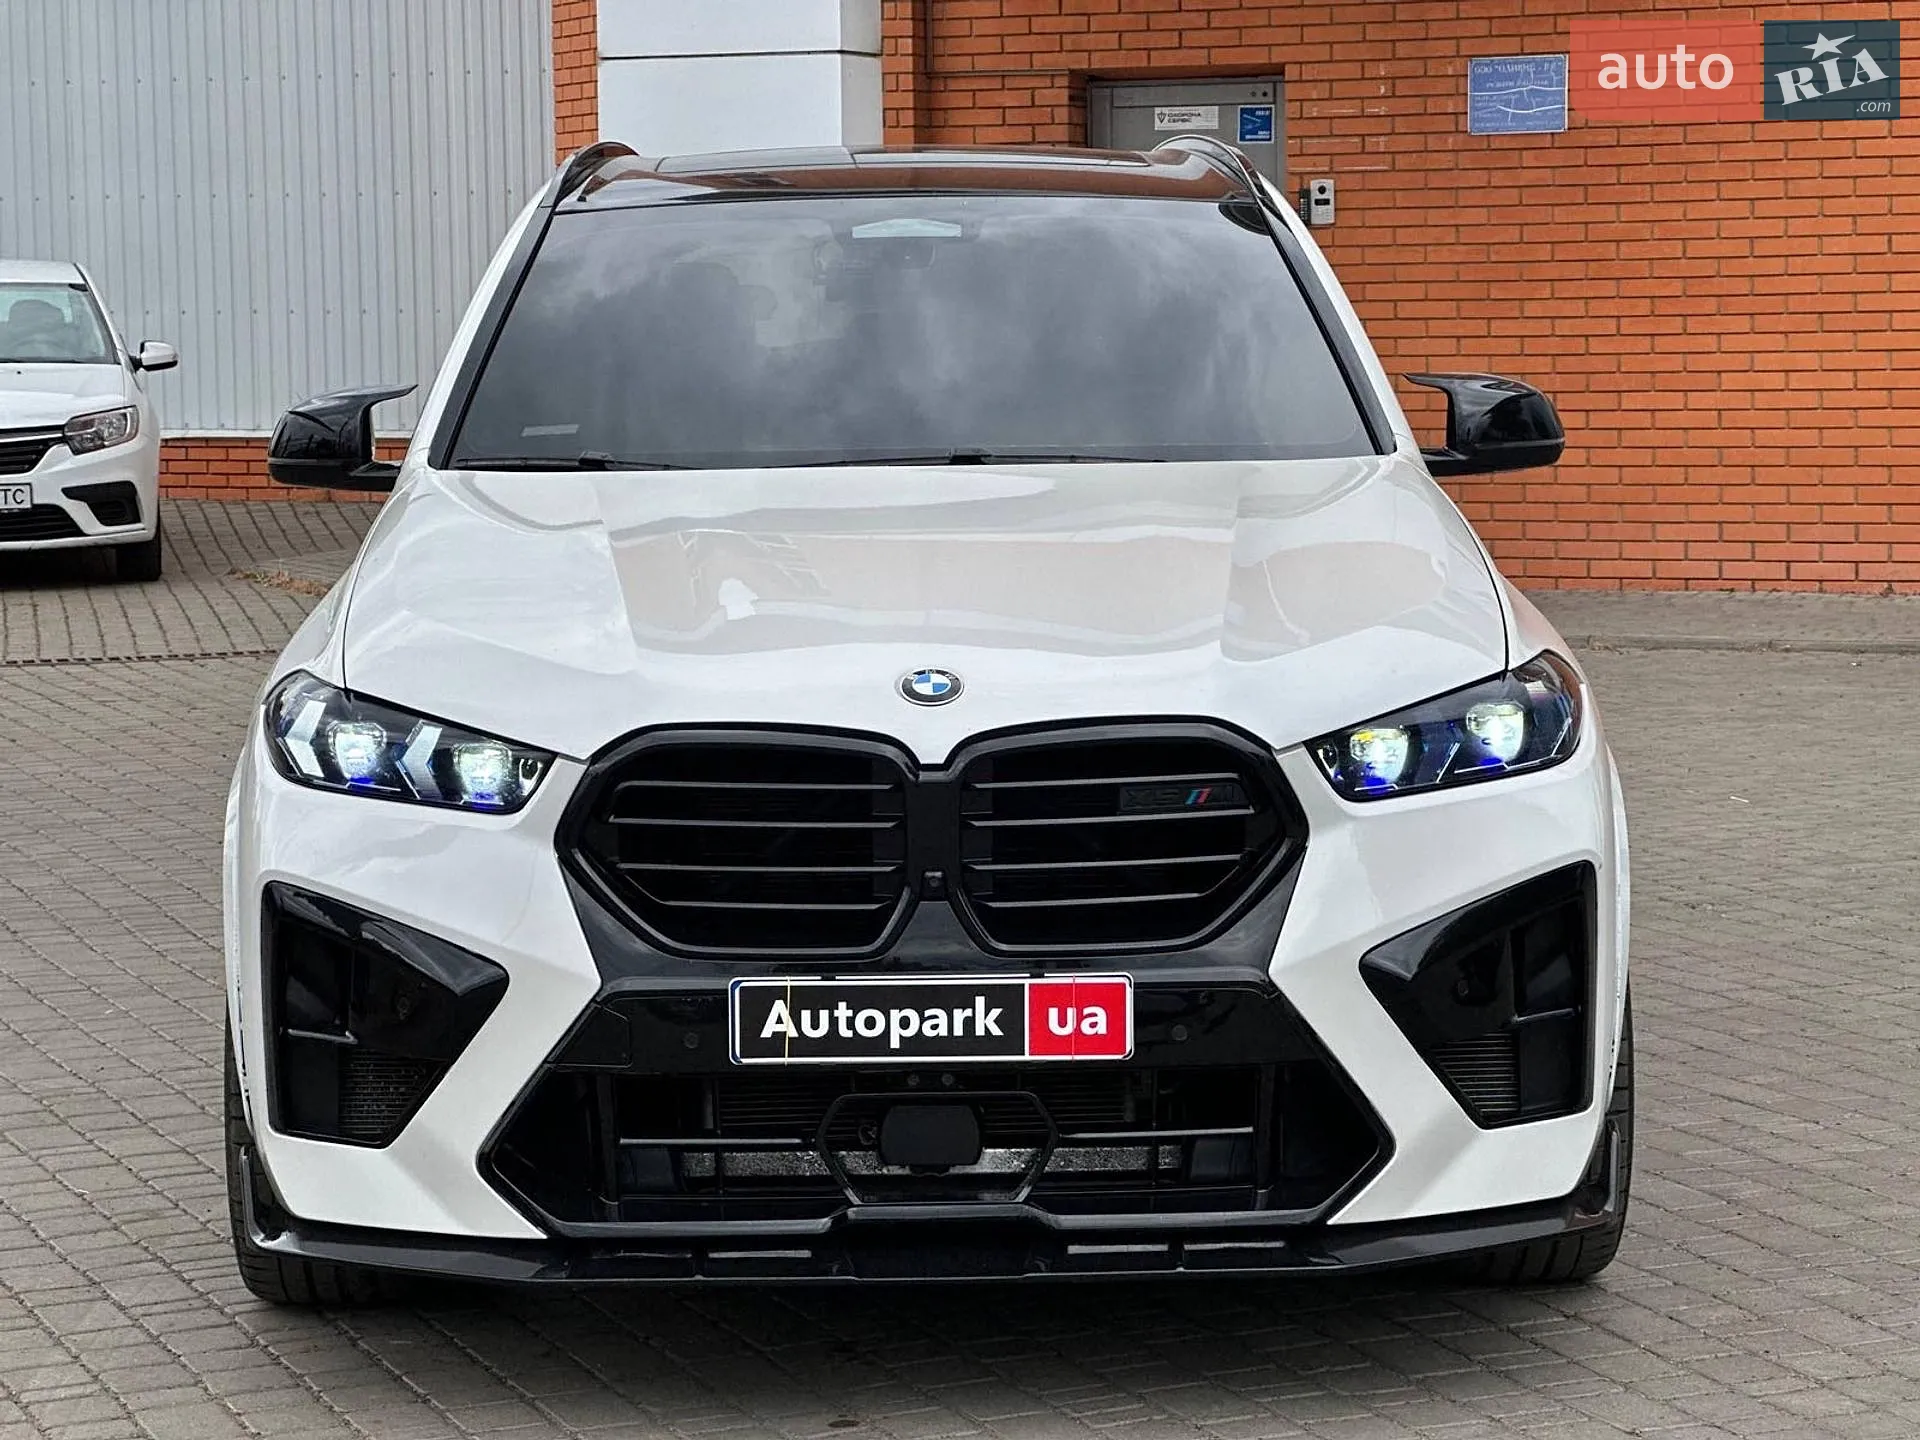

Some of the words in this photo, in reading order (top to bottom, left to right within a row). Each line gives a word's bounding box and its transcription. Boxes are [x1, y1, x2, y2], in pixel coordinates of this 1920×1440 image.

[0, 488, 25, 505] TC
[760, 995, 1004, 1049] Autopark
[1047, 1005, 1108, 1036] ua
